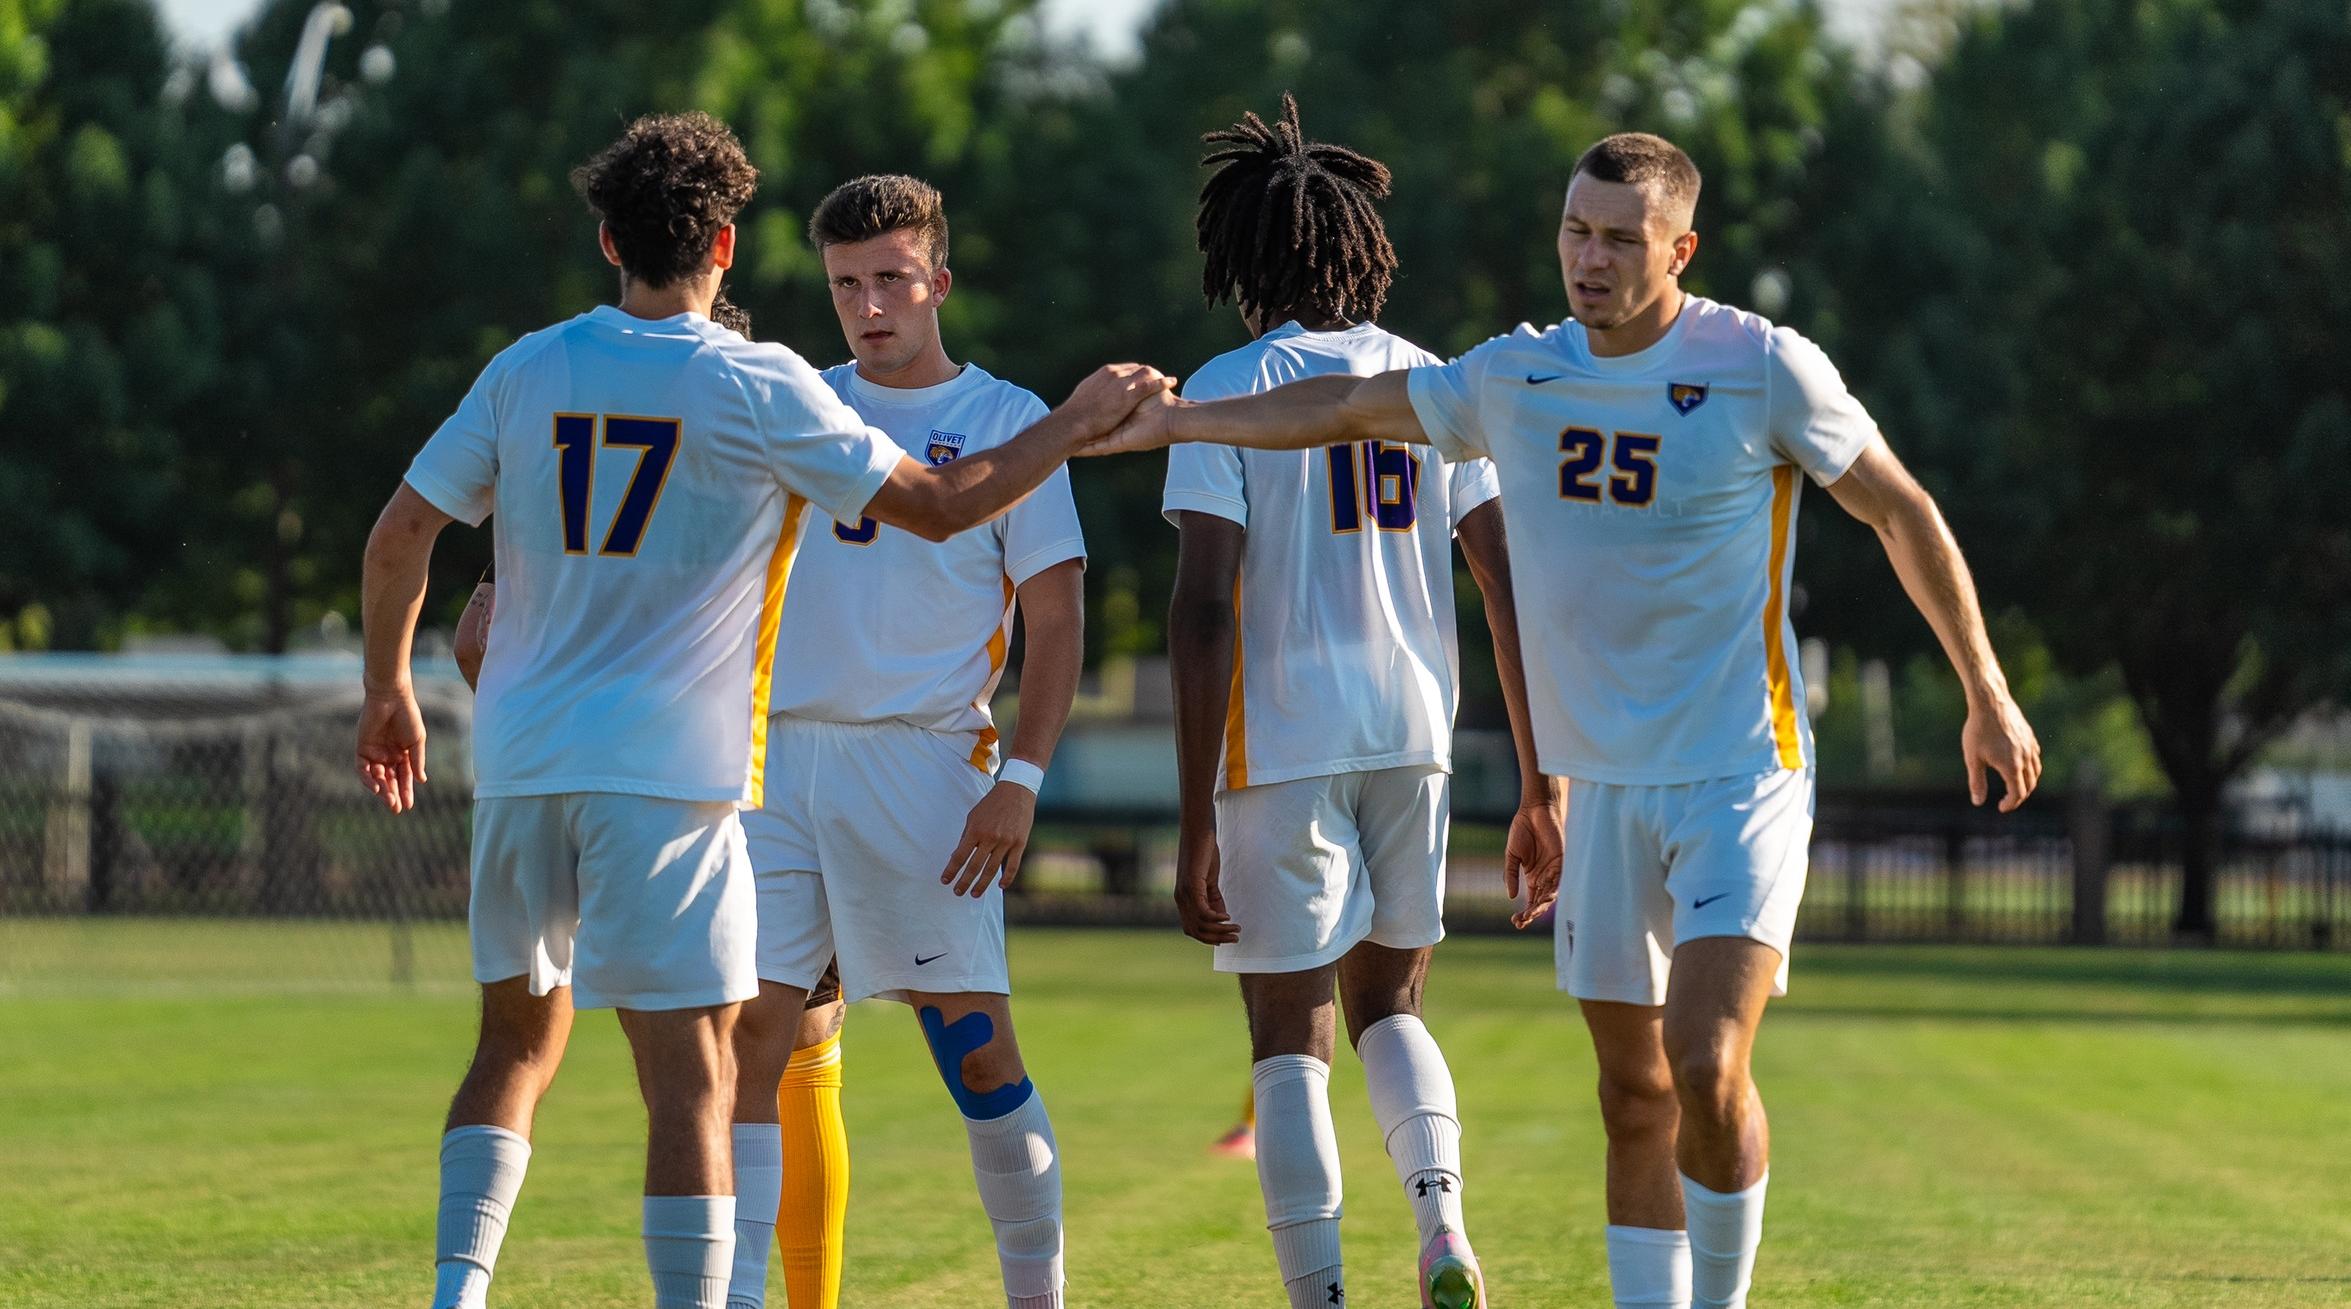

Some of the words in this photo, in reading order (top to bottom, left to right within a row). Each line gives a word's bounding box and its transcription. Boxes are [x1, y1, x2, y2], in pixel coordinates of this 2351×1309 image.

[932, 432, 964, 445] OLIVET
[1558, 425, 1662, 509] 25
[553, 412, 682, 558] 17
[1324, 439, 1422, 535] 16
